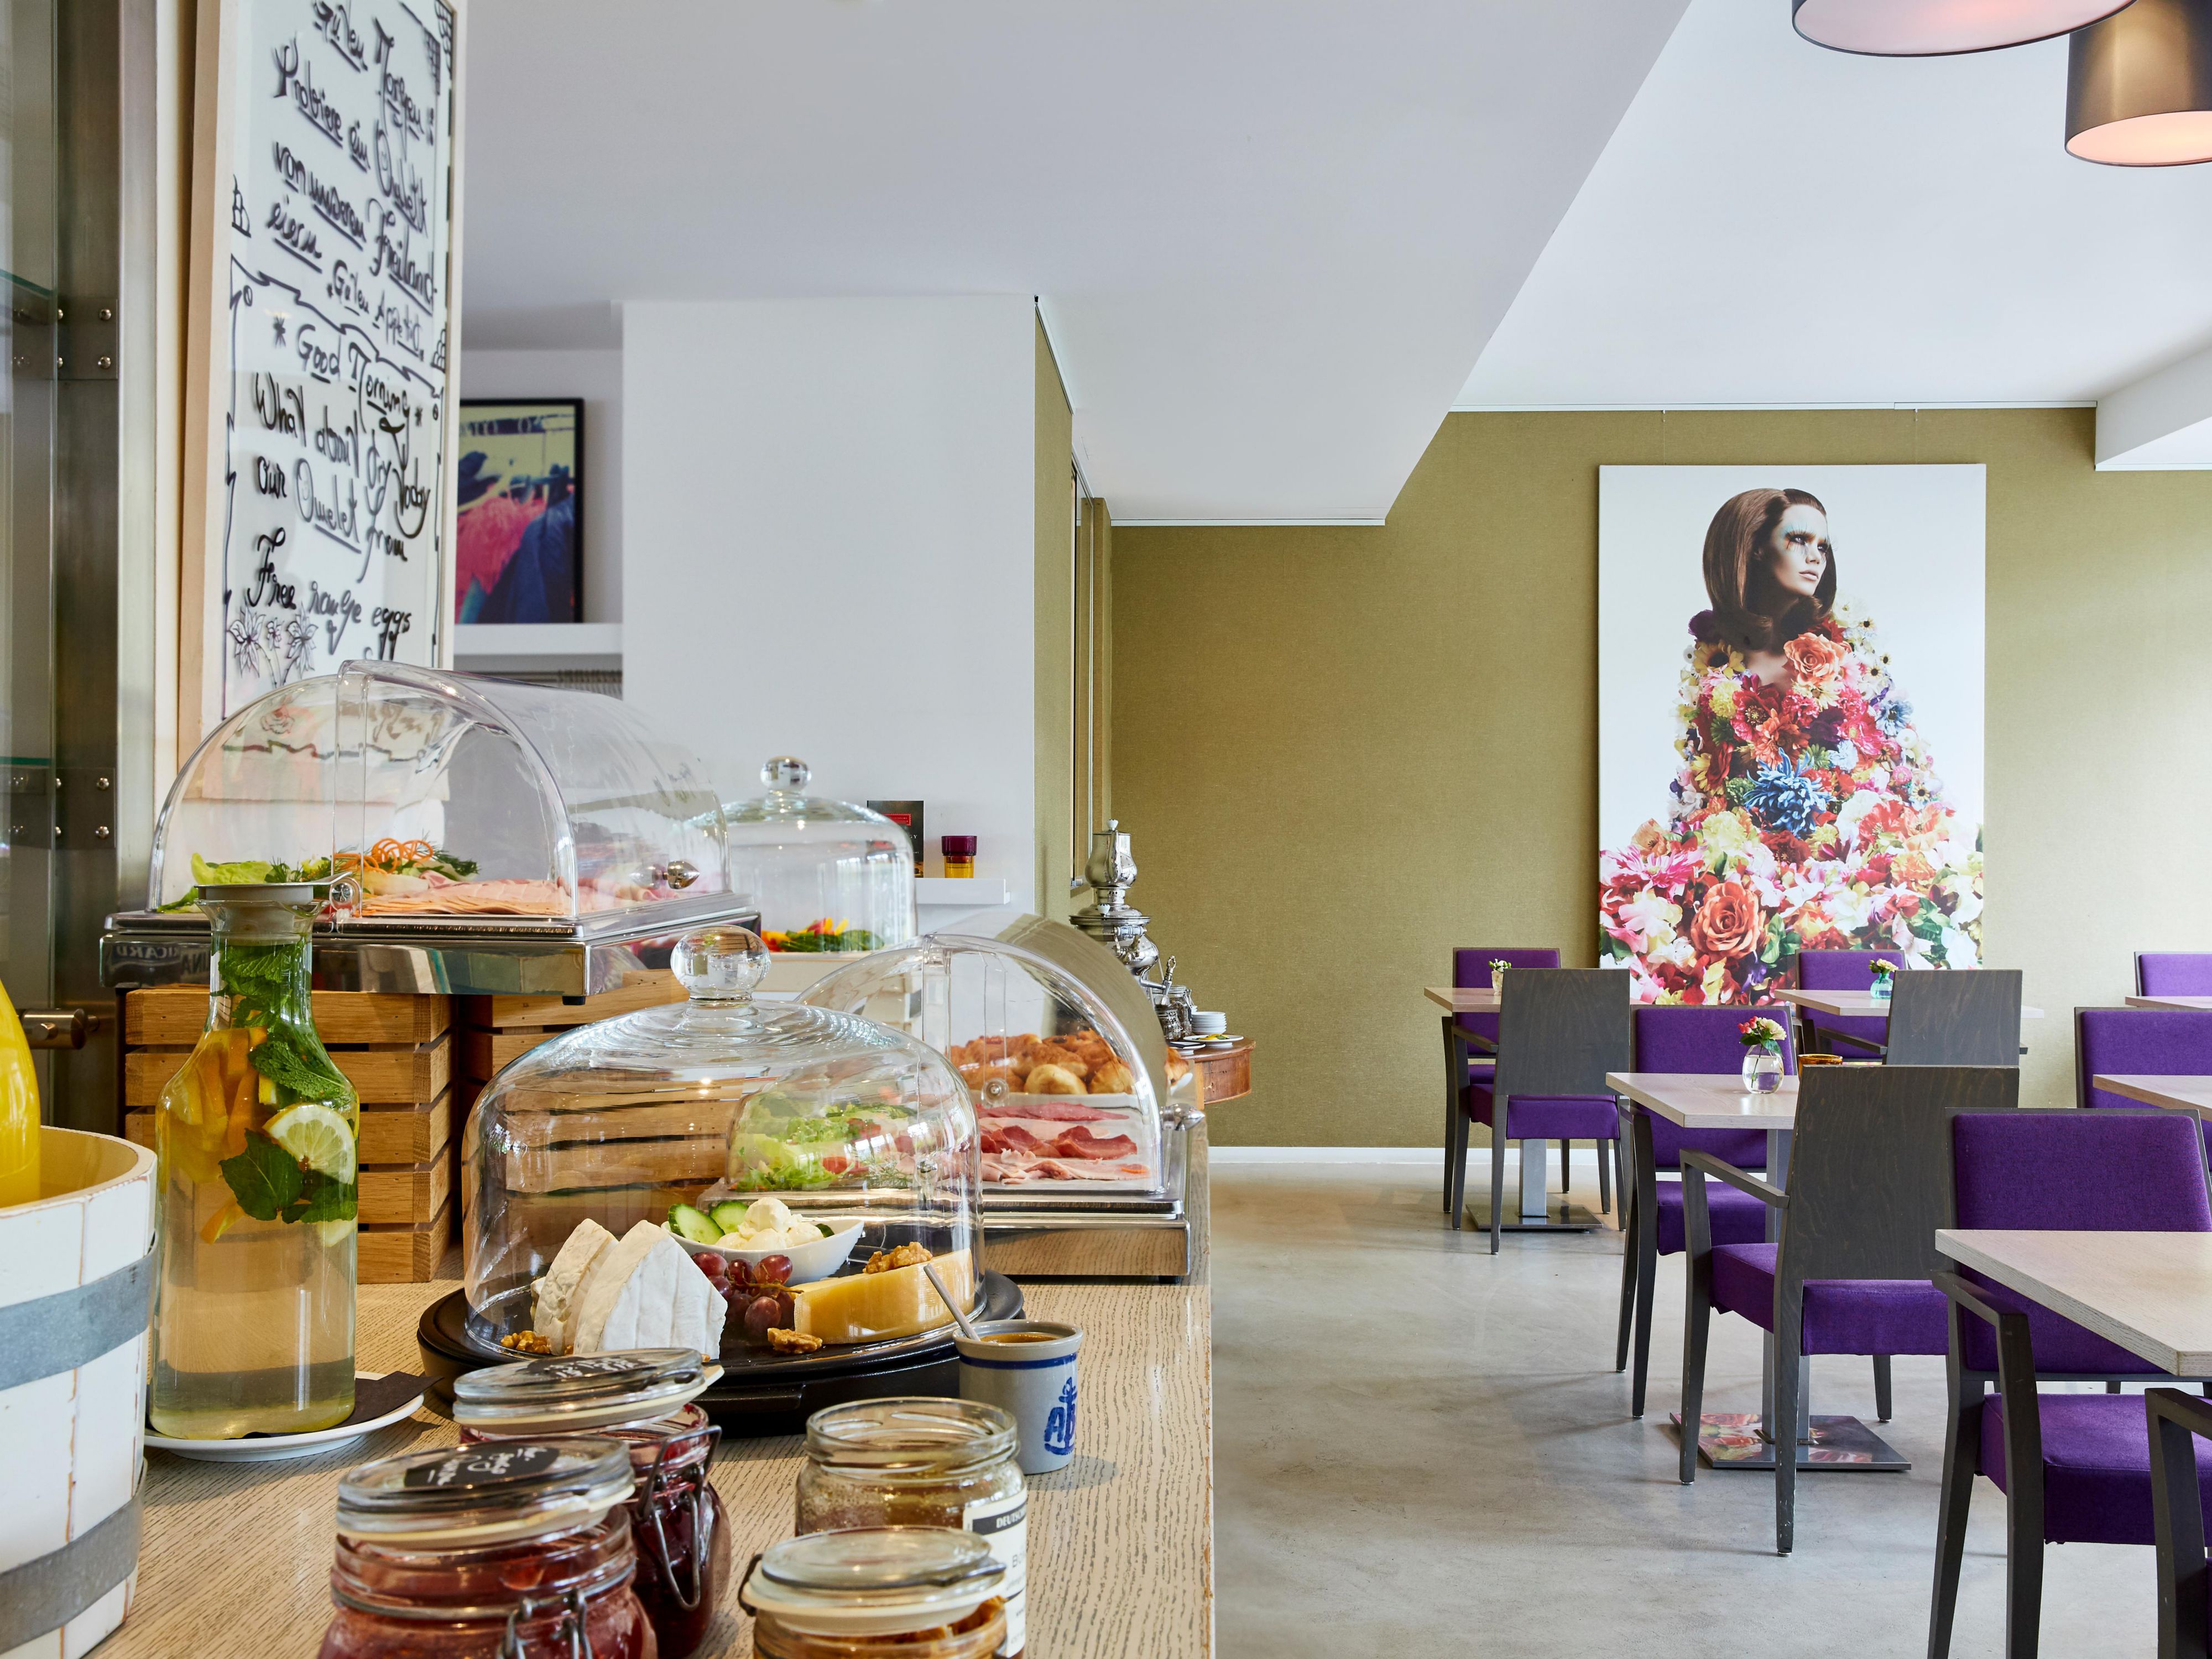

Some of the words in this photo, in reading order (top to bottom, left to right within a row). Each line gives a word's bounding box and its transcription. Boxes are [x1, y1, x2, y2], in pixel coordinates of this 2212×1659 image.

[273, 30, 343, 142] Probiere
[349, 120, 371, 169] ein
[273, 142, 306, 195] von
[309, 171, 367, 242] unseren
[333, 259, 369, 314] Guten
[255, 372, 307, 447] What
[315, 405, 359, 478] about
[297, 324, 341, 381] Good
[349, 342, 411, 470] Morning
[296, 458, 359, 543] Omelet
[357, 524, 408, 584] from
[247, 527, 297, 609] Free
[309, 581, 362, 655] range
[371, 607, 412, 660] eggs
